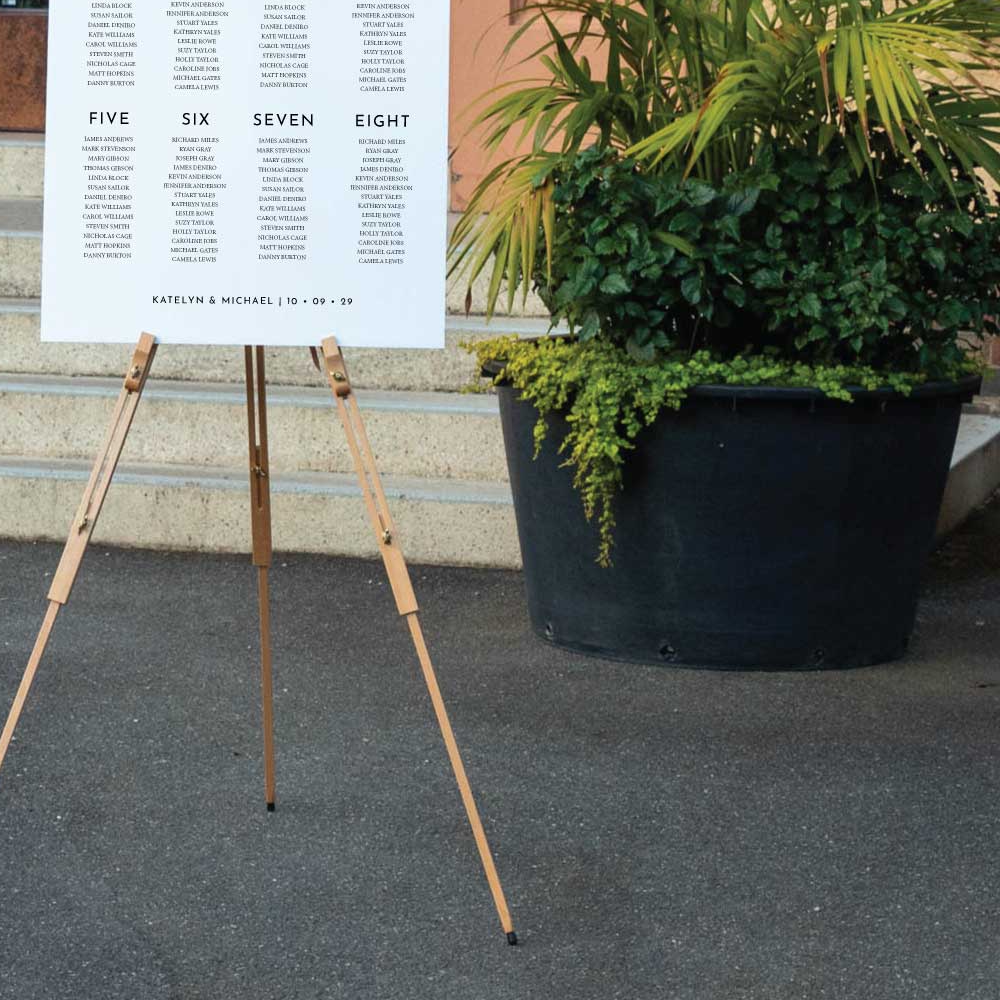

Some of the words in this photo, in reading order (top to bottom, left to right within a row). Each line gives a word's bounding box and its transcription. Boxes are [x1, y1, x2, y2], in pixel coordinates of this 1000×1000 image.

[90, 112, 129, 124] FIVE
[182, 113, 209, 125] SIX
[254, 114, 313, 126] SEVEN
[356, 115, 409, 127] EIGHT
[153, 296, 203, 304] KATELYN
[209, 296, 215, 304] &
